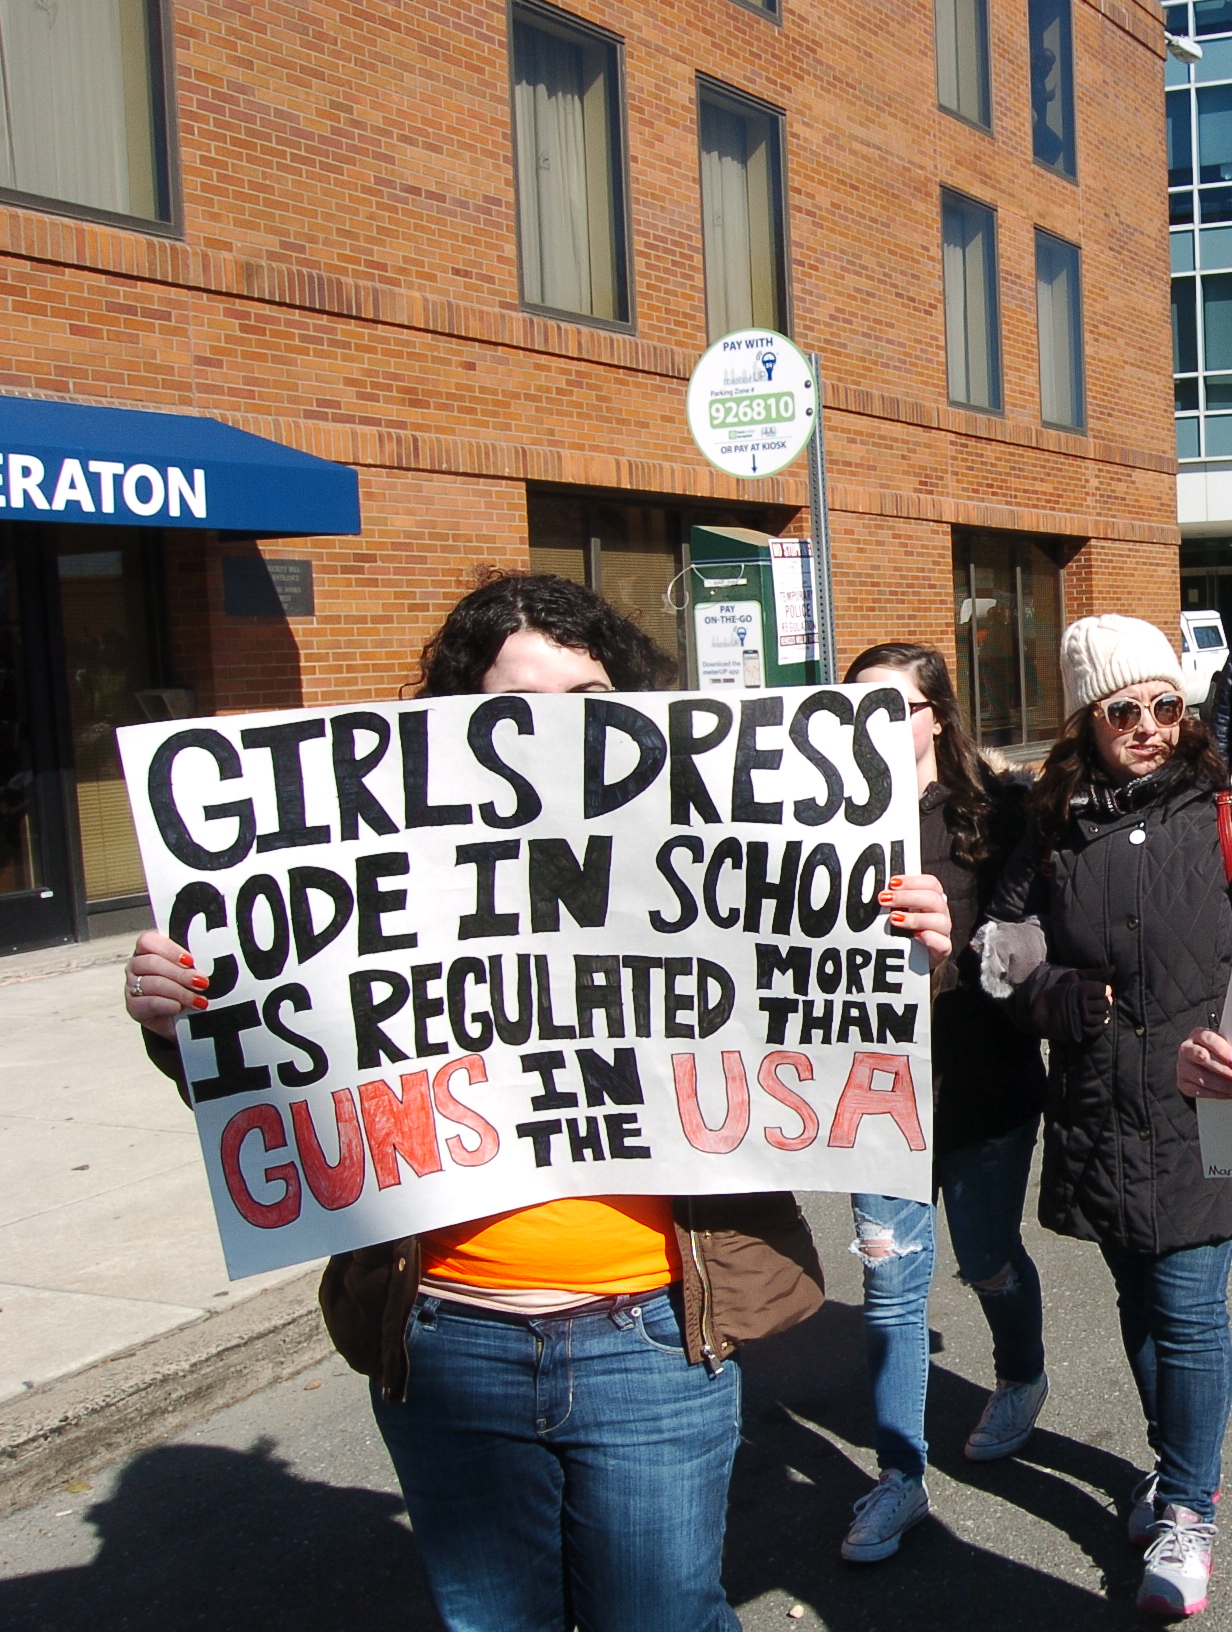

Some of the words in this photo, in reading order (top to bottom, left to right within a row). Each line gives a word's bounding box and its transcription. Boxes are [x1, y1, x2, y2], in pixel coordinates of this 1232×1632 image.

[723, 340, 743, 351] PAY
[745, 337, 774, 349] WITH
[710, 389, 734, 397] Parking
[734, 387, 750, 395] Zone
[710, 396, 794, 425] 926810
[720, 445, 733, 455] OR
[734, 444, 748, 453] PAY
[750, 443, 760, 452] AT
[762, 440, 787, 450] KIOSK
[0, 453, 208, 519] RATON
[704, 615, 752, 624] ON-THE-GO
[719, 605, 735, 613] PAY
[785, 603, 811, 618] POLICE
[148, 696, 542, 871] GIRLS
[584, 688, 906, 827] DRESS
[169, 851, 419, 1000] CODE
[455, 835, 613, 940] IN
[755, 943, 906, 996] MORE
[187, 982, 329, 1104] IS
[348, 953, 735, 1071] REGULATED
[759, 996, 919, 1046] THAN
[519, 1046, 645, 1112] IN
[671, 1050, 927, 1154] USA
[220, 1053, 500, 1230] GUNS
[515, 1112, 652, 1168] THE
